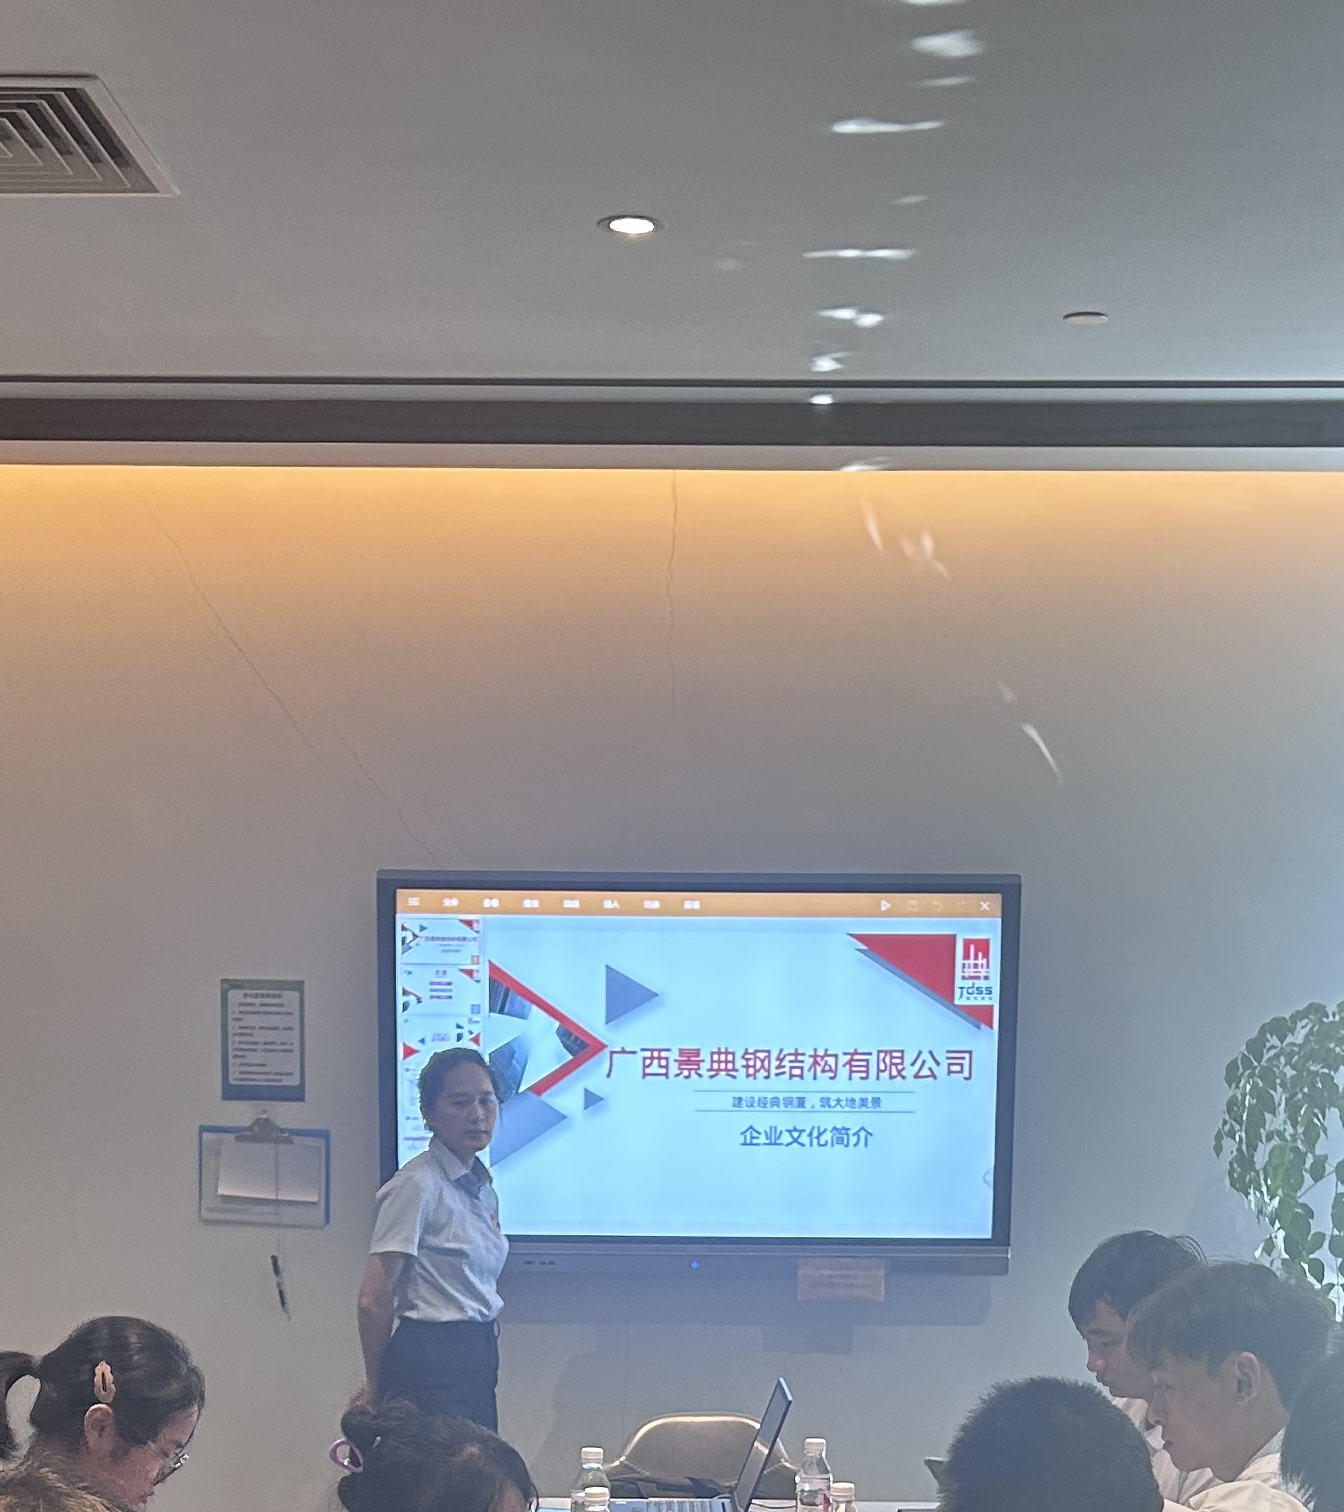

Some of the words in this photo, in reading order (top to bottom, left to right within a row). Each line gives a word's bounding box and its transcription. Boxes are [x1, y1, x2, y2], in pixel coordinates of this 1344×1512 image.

[606, 1047, 974, 1081] 广西景典钢结构有限公司
[739, 1125, 873, 1148] 企业文化简介
